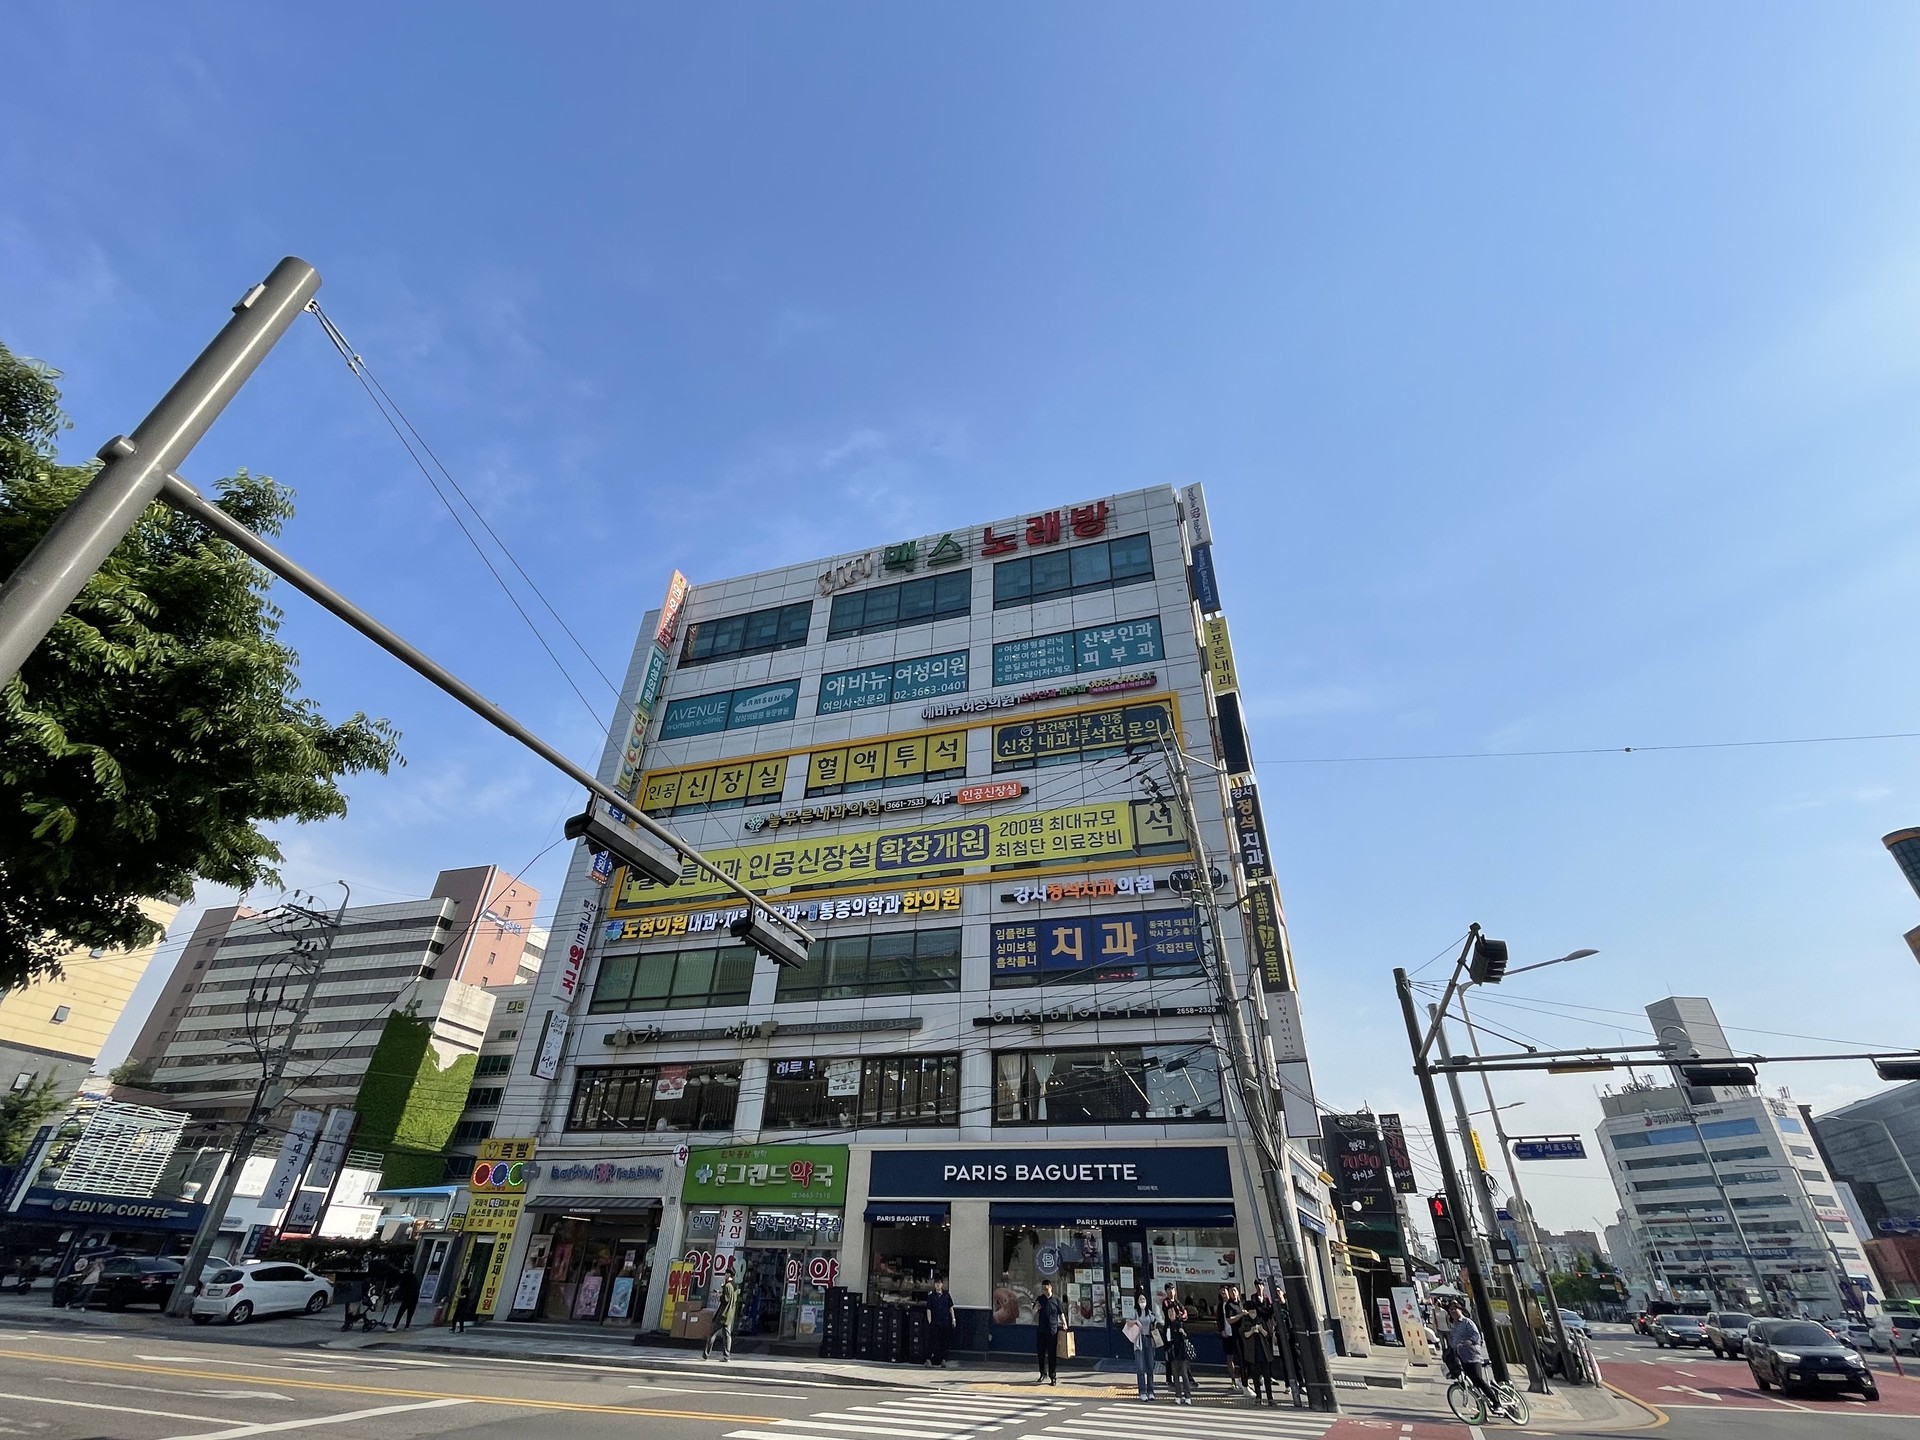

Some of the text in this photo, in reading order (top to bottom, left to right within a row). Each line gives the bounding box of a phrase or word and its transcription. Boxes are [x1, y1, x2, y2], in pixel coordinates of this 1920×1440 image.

[883, 500, 1109, 572] 맥스 노래방
[1082, 622, 1153, 649] 산부인과
[1083, 641, 1155, 667] 피부과
[1209, 622, 1236, 686] 늘푸른내과
[895, 655, 967, 685] 여성의원
[893, 680, 967, 701] 02-3663-0401
[668, 694, 788, 722] AVENUE SAMSUNG
[1100, 713, 1123, 726] 인증
[816, 738, 958, 783] 혈액투석
[649, 765, 779, 800] 인공 신장실
[767, 783, 1017, 829] 늘푸른내과의원 3661-7533 4F 인공신장실
[750, 841, 871, 881] 인공신장실
[880, 829, 985, 866] 확장개원
[1000, 818, 1044, 837] 200평
[1049, 810, 1116, 832] 최대규모
[995, 829, 1122, 858] 최첨단 의료장비
[1251, 868, 1265, 878] 3F
[903, 886, 962, 914] 한의원
[995, 927, 1036, 940] 임플란트
[1052, 921, 1138, 961] 치과
[1264, 950, 1281, 983] COFFEE
[1176, 1006, 1217, 1015] 2658-2326
[944, 1163, 1138, 1180] PARIS BAGUETTE
[69, 1200, 170, 1218] EDIYA COFFEE
[1076, 1218, 1138, 1226] PARIS BAGUETTE
